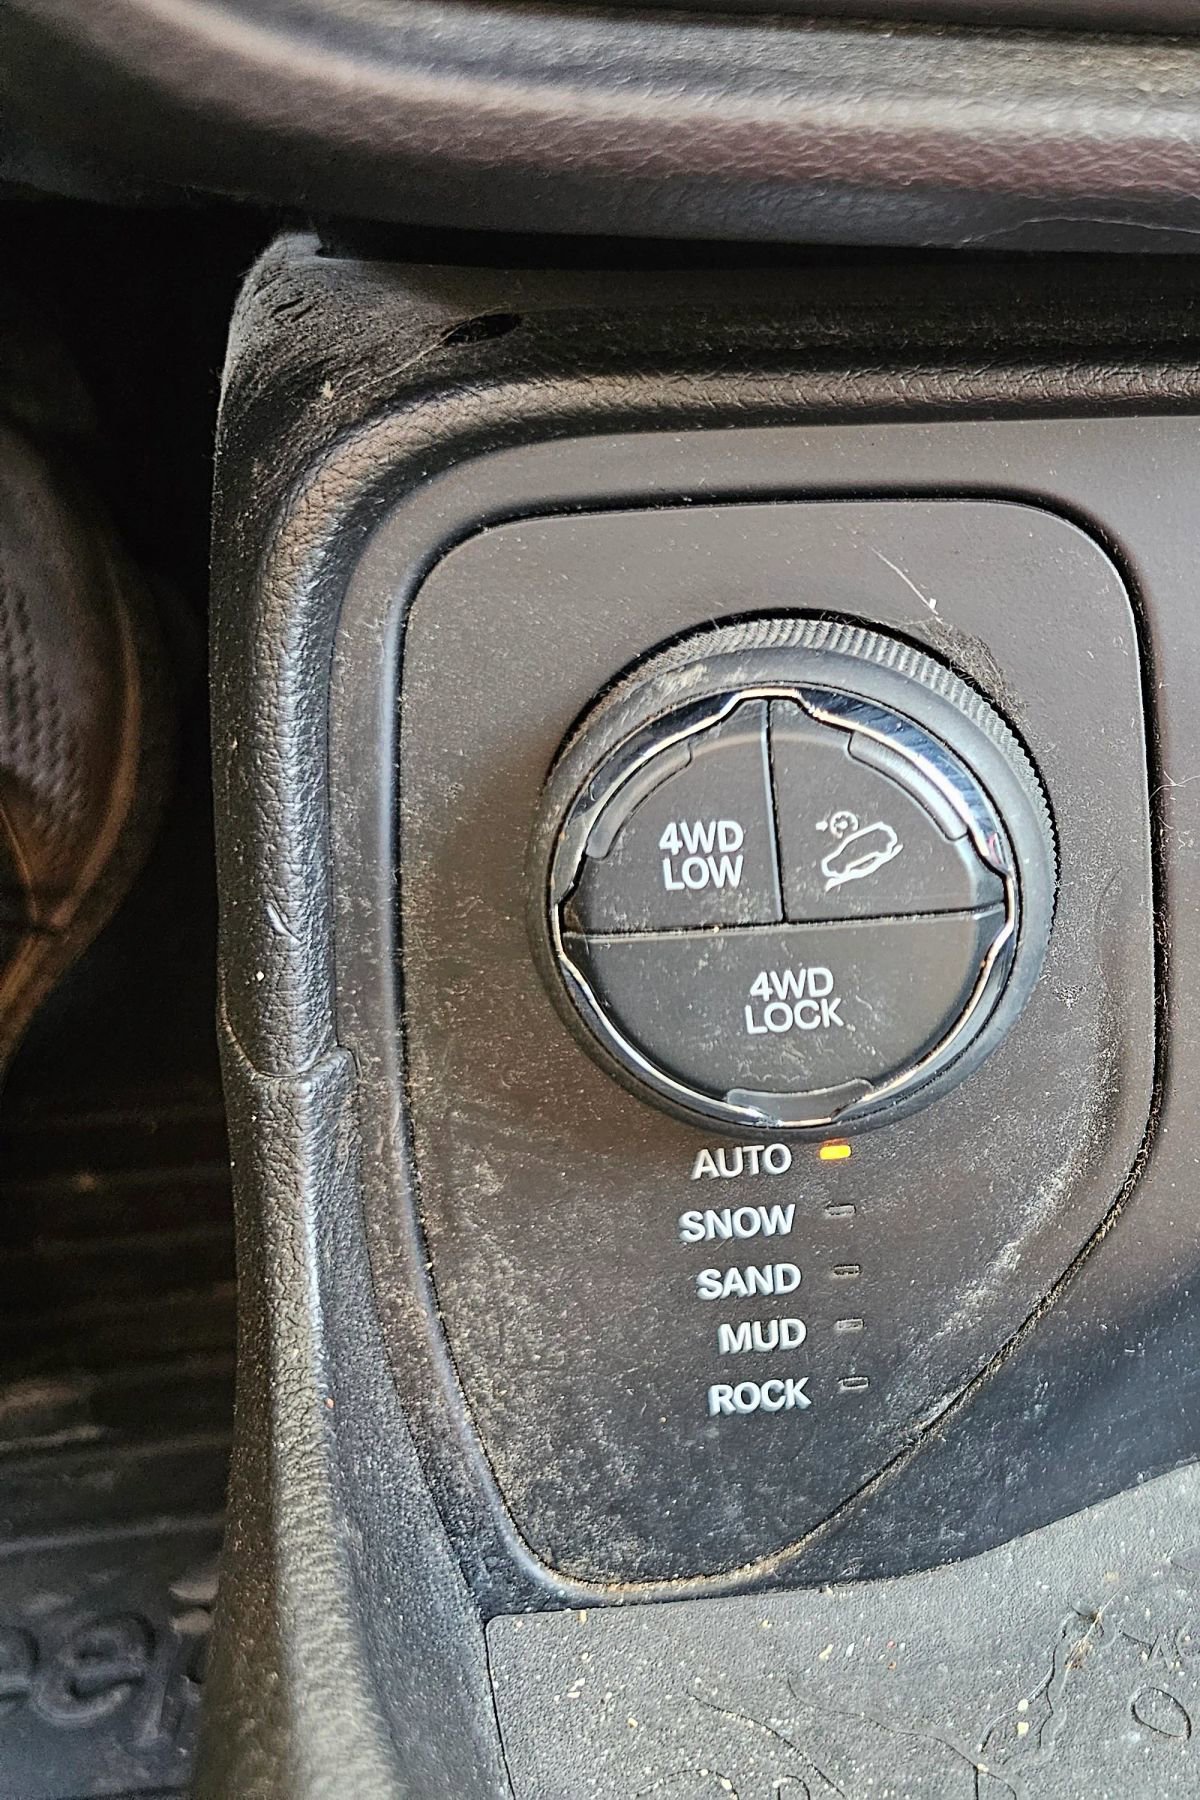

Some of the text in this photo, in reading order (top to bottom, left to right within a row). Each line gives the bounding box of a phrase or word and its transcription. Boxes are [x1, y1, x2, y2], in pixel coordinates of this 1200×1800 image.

[658, 819, 744, 856] 4WD
[662, 854, 744, 891] LOW
[749, 967, 834, 1002] 4WD
[744, 997, 845, 1035] LOCK
[690, 1143, 793, 1180] AUTO
[677, 1203, 796, 1243] SNOW
[697, 1262, 802, 1300] SAND
[717, 1318, 808, 1355] MUD
[706, 1376, 812, 1417] ROCK
